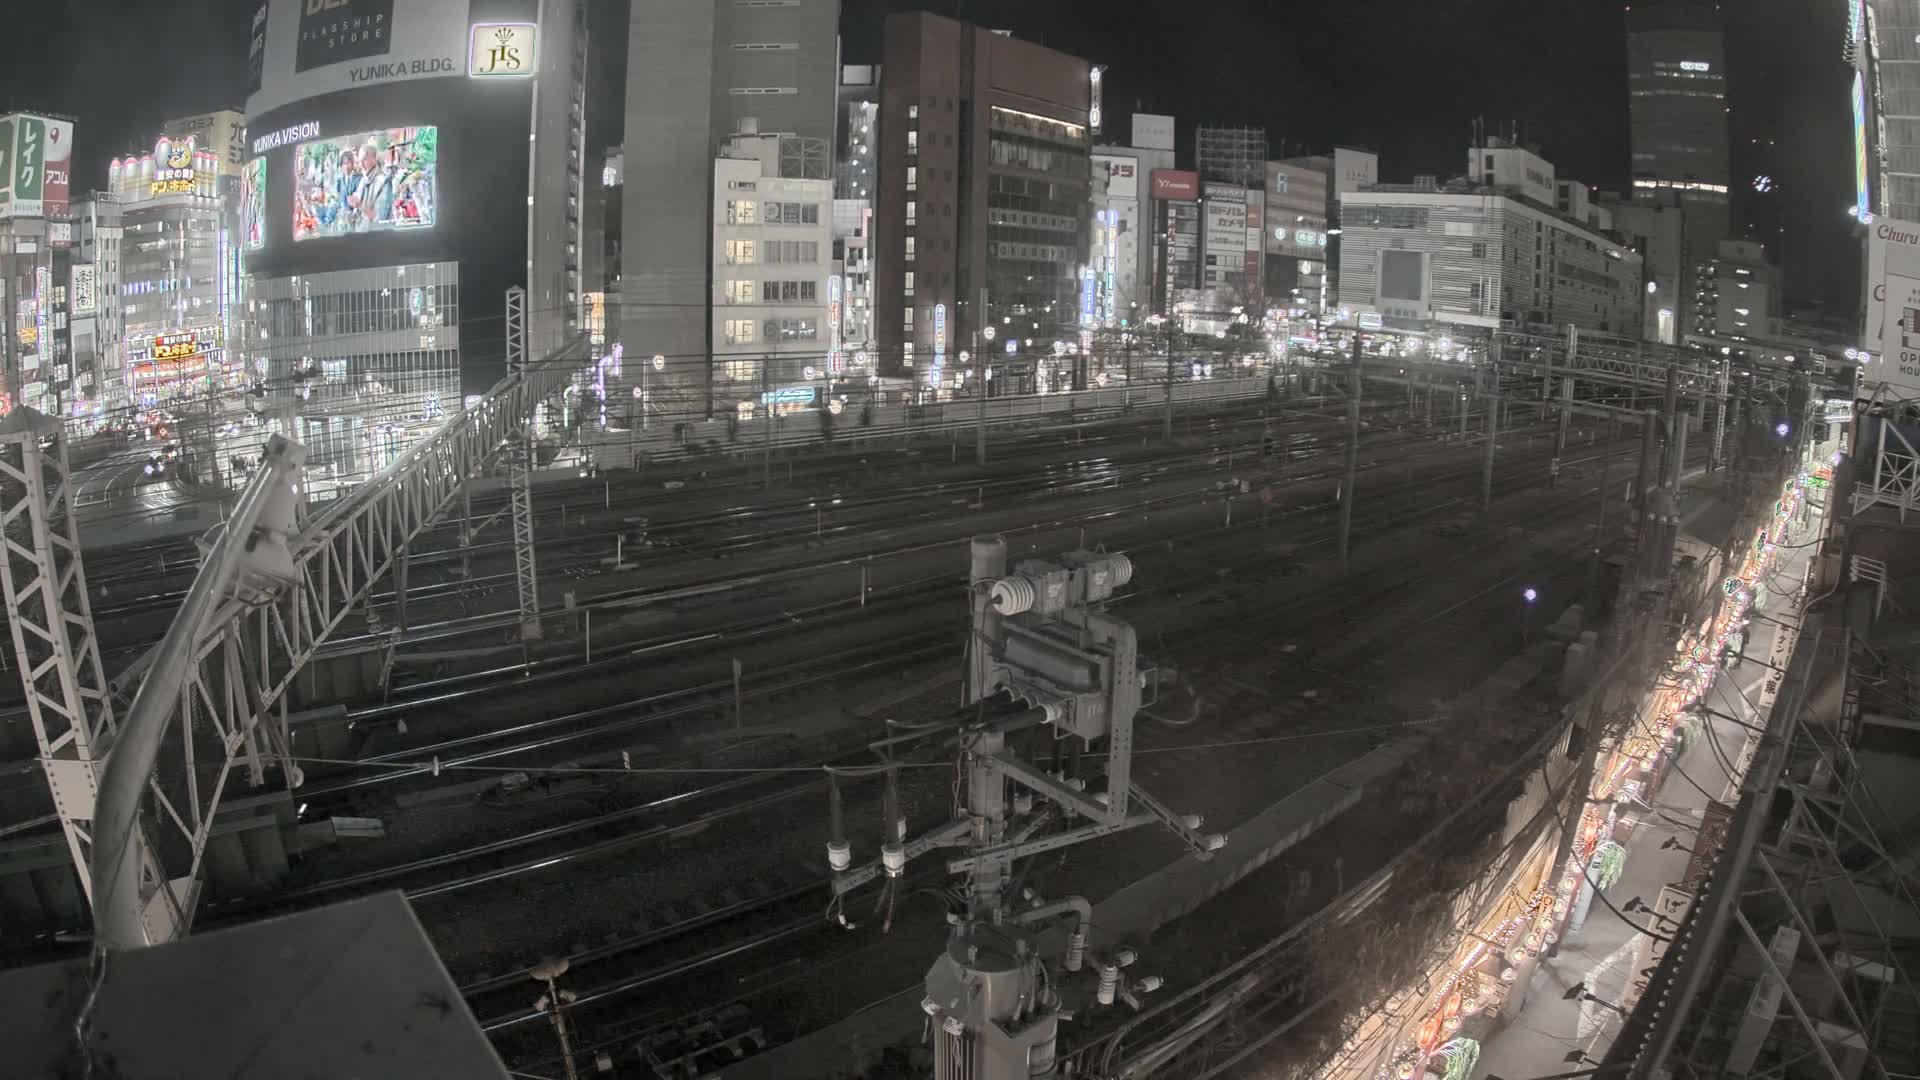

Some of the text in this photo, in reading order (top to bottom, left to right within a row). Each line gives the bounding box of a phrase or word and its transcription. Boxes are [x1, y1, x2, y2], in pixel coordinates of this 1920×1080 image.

[328, 28, 381, 48] STORE
[349, 58, 456, 81] YUNIKA BLDG.
[253, 120, 321, 153] YUNIKA VISION
[20, 121, 37, 188] レイク
[45, 169, 69, 185] アコム
[1900, 351, 1920, 365] OP
